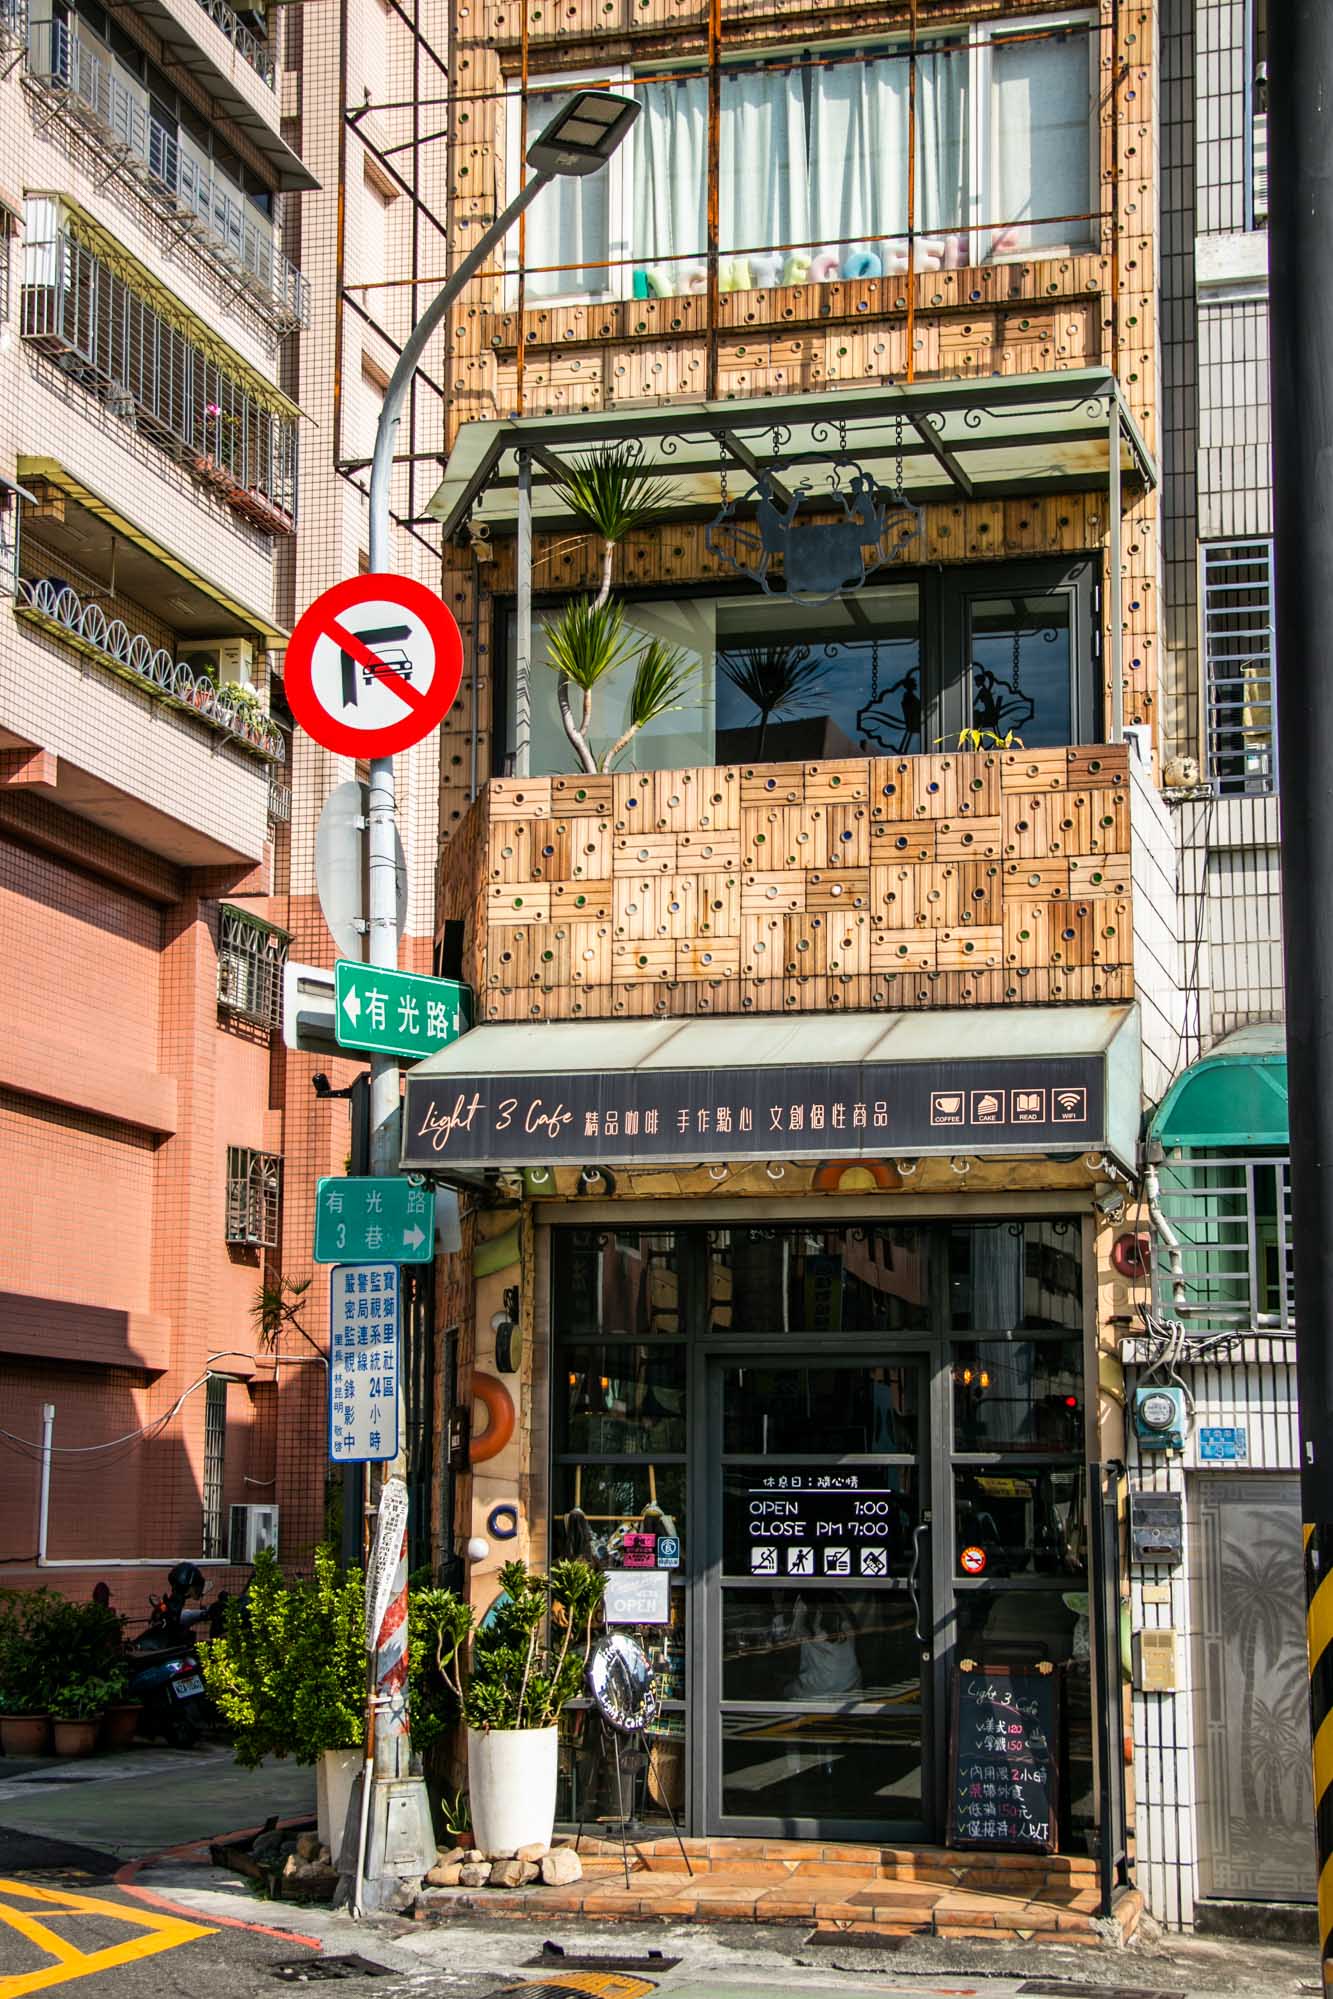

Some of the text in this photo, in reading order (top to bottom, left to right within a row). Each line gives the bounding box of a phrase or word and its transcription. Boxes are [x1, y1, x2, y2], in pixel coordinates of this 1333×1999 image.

[364, 987, 449, 1040] 有光路
[418, 1093, 888, 1151] Light 3 Cafe 精品咖啡 手作點心 文創個性商品
[935, 1115, 960, 1123] COFFEE
[978, 1114, 996, 1122] CAKE
[1019, 1113, 1038, 1121] READ
[326, 1189, 426, 1214] 有光路
[336, 1223, 384, 1250] 3巷
[749, 1501, 799, 1515] OPEN
[749, 1521, 889, 1537] CLOSE PM 7:00
[967, 1681, 998, 1705] Light
[1001, 1692, 1013, 1706] 3
